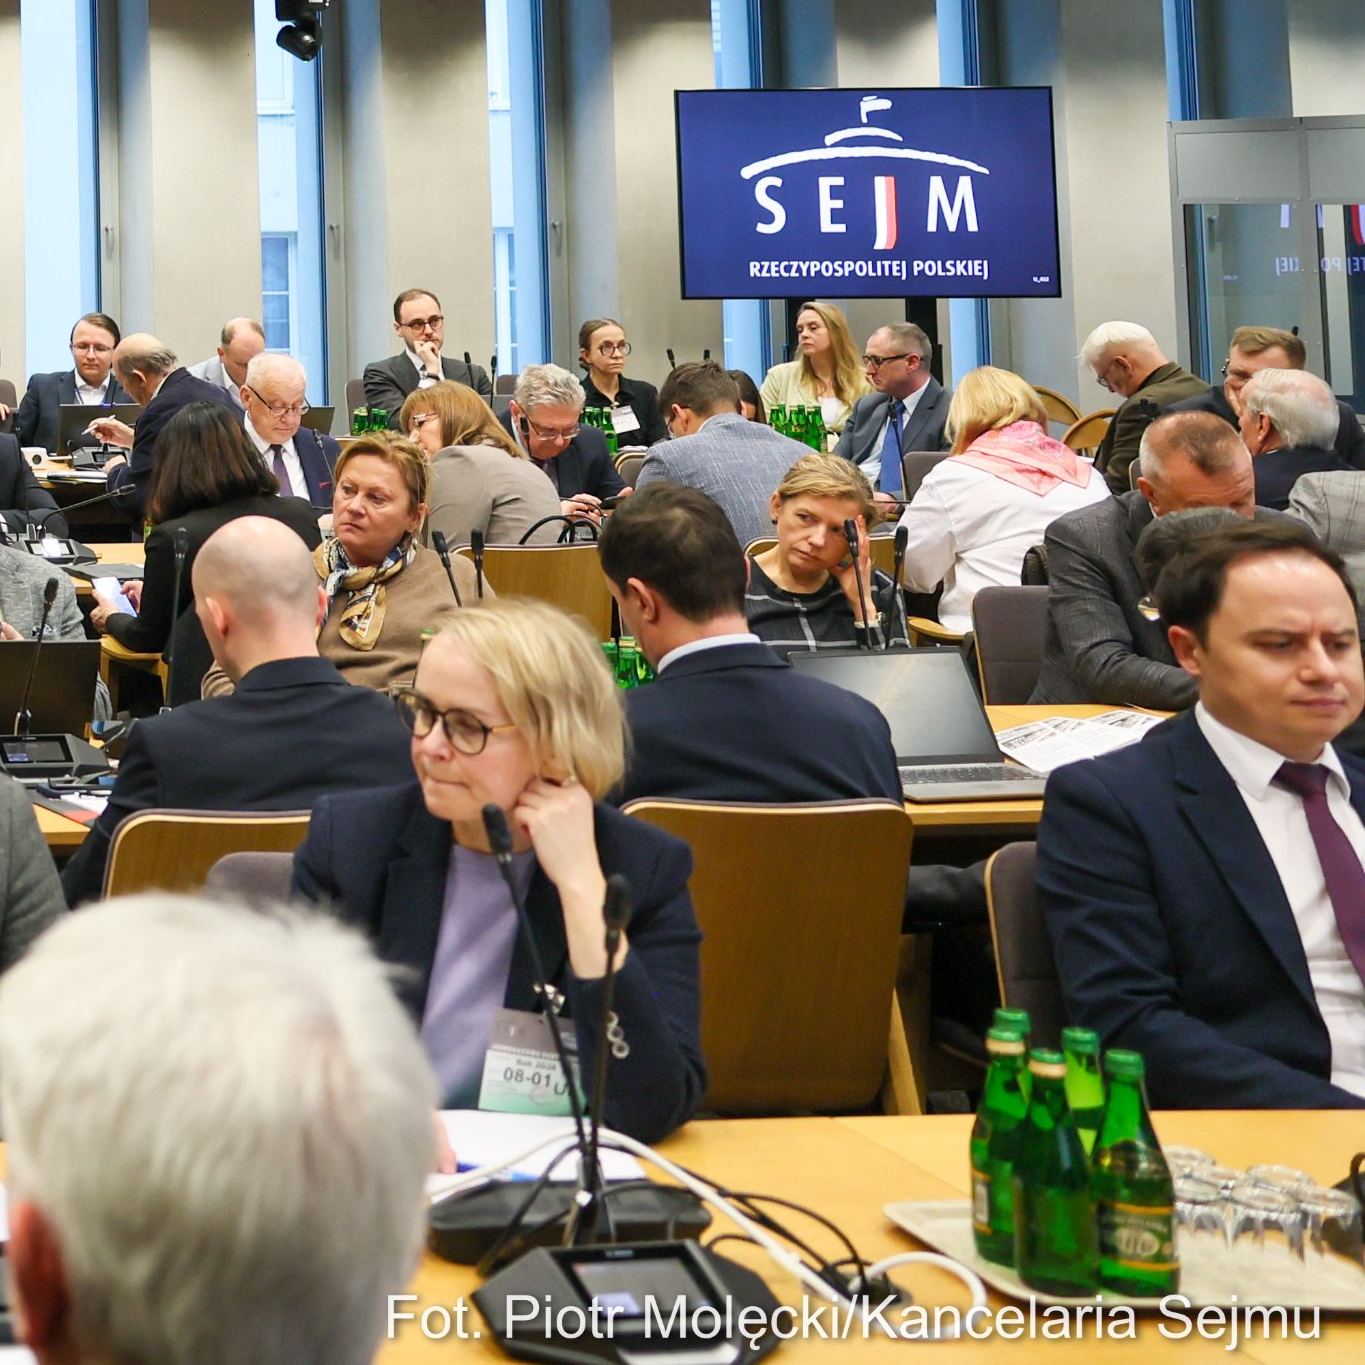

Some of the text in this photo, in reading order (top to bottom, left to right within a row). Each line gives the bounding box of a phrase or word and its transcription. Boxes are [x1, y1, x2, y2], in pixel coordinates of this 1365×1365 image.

[753, 175, 980, 251] SEJM
[749, 259, 990, 281] RZECZYPOSPOLITEJ POLSKIEJ
[503, 1066, 552, 1089] 08-01
